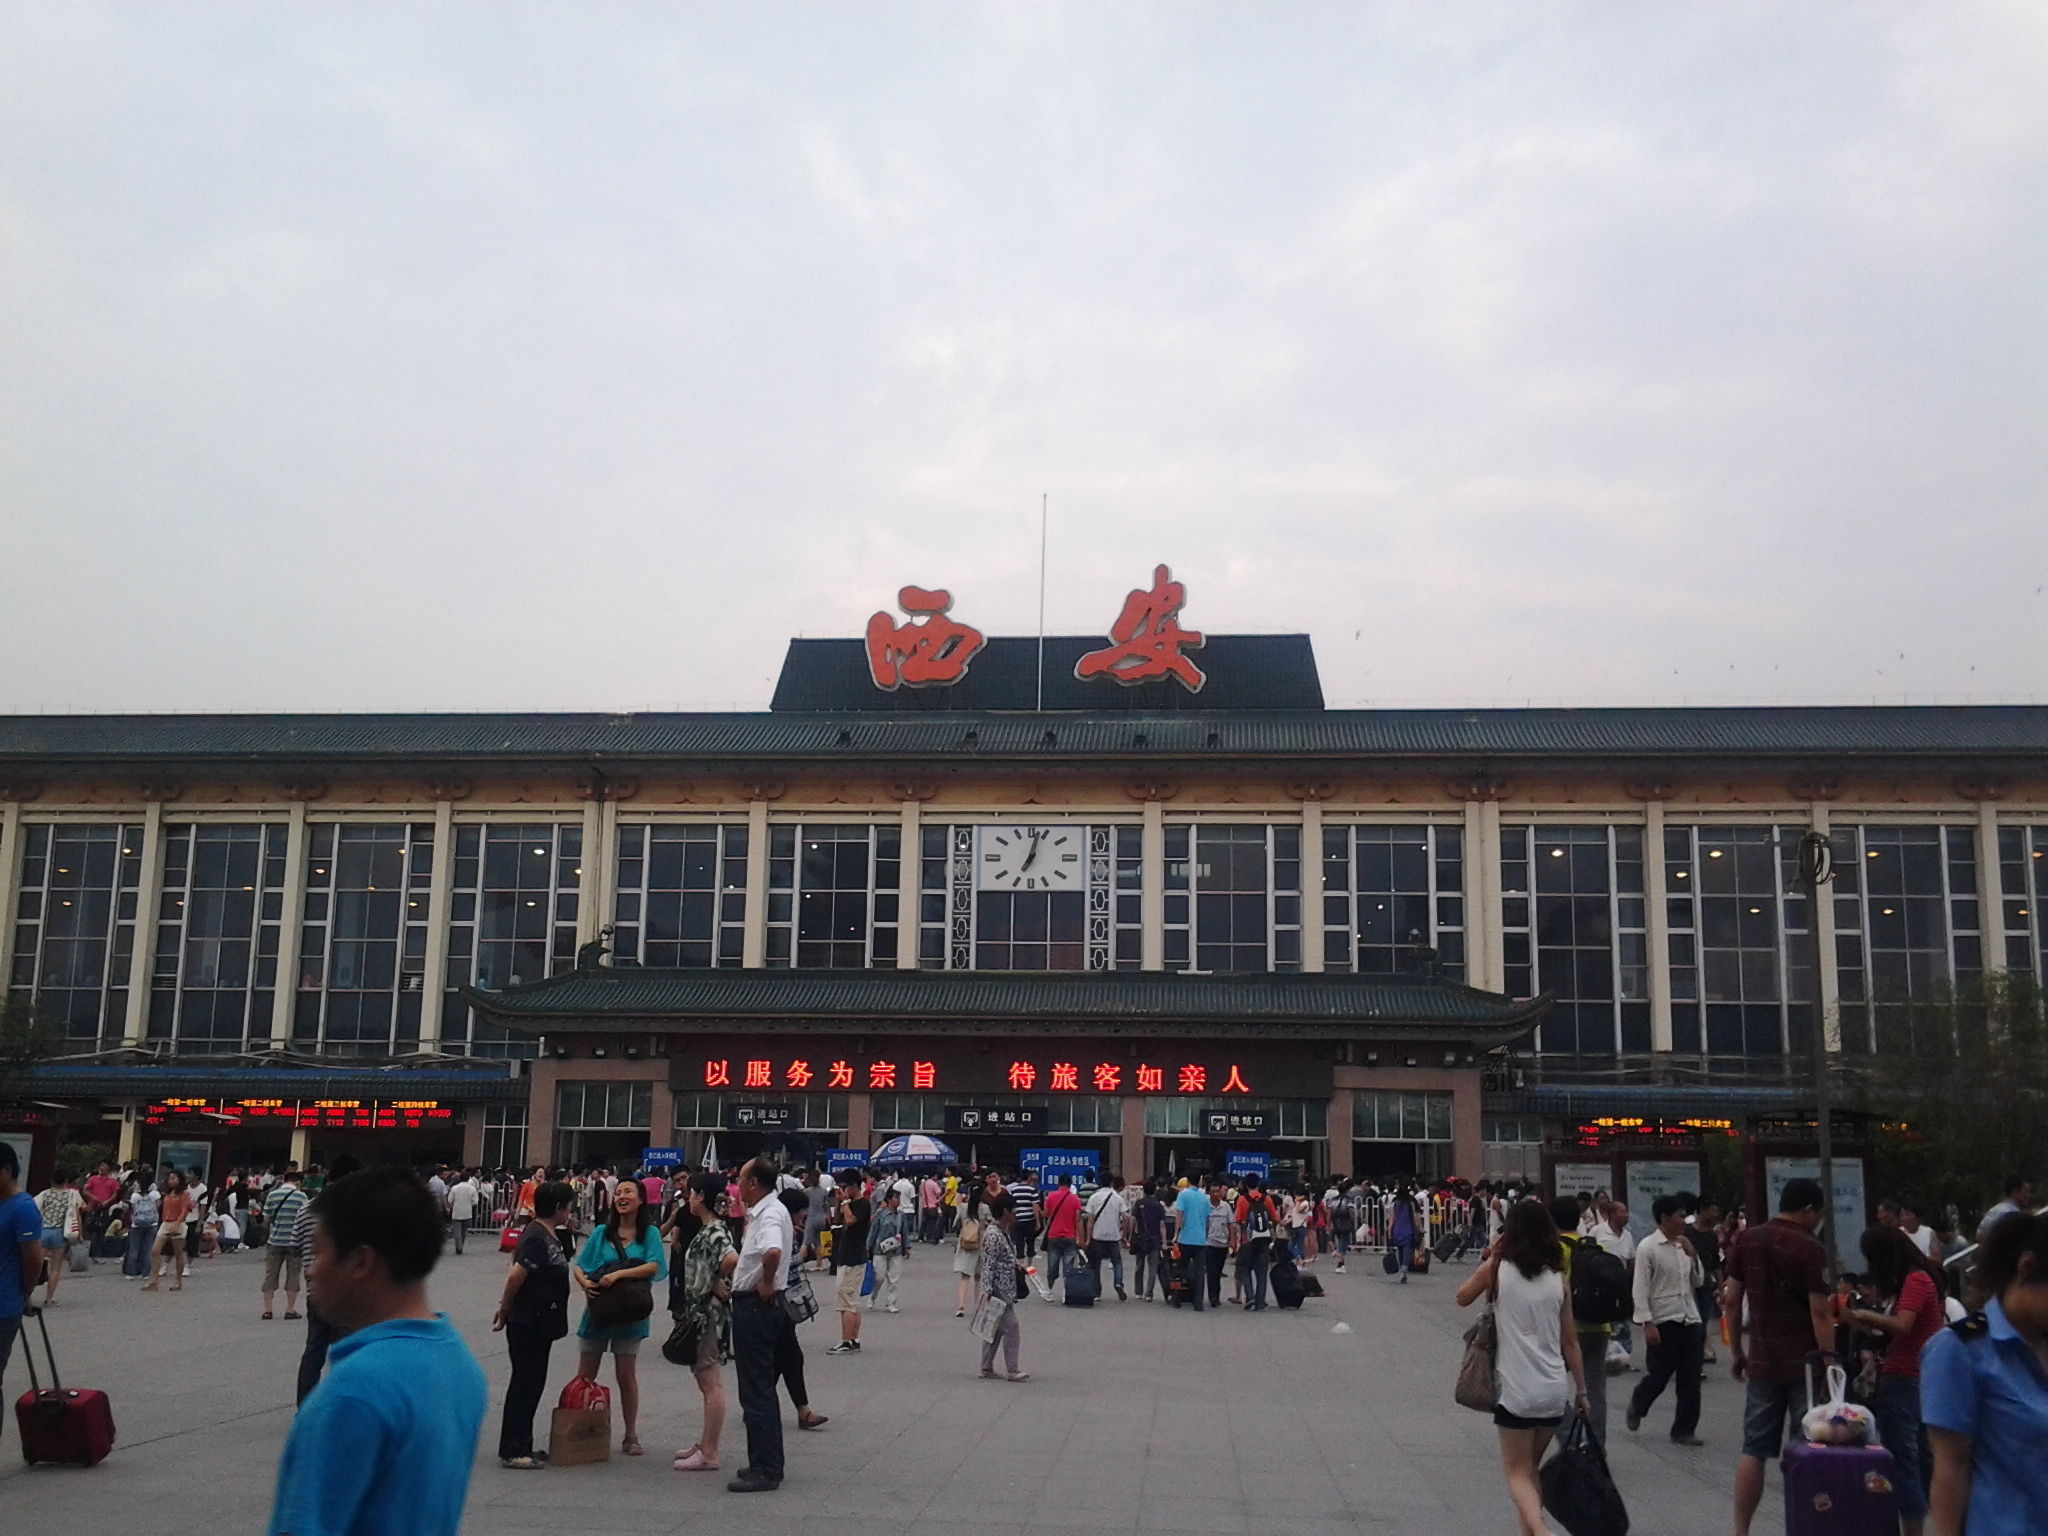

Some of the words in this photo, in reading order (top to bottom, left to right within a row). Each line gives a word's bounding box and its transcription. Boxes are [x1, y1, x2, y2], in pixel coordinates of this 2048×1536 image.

[865, 563, 1206, 695] 西安
[705, 1060, 936, 1089] 以服务为宗旨
[1008, 1062, 1250, 1093] 待旅客如亲人
[757, 1109, 788, 1119] 进站口
[987, 1111, 1032, 1122] 进站口
[1230, 1115, 1263, 1126] 进站口
